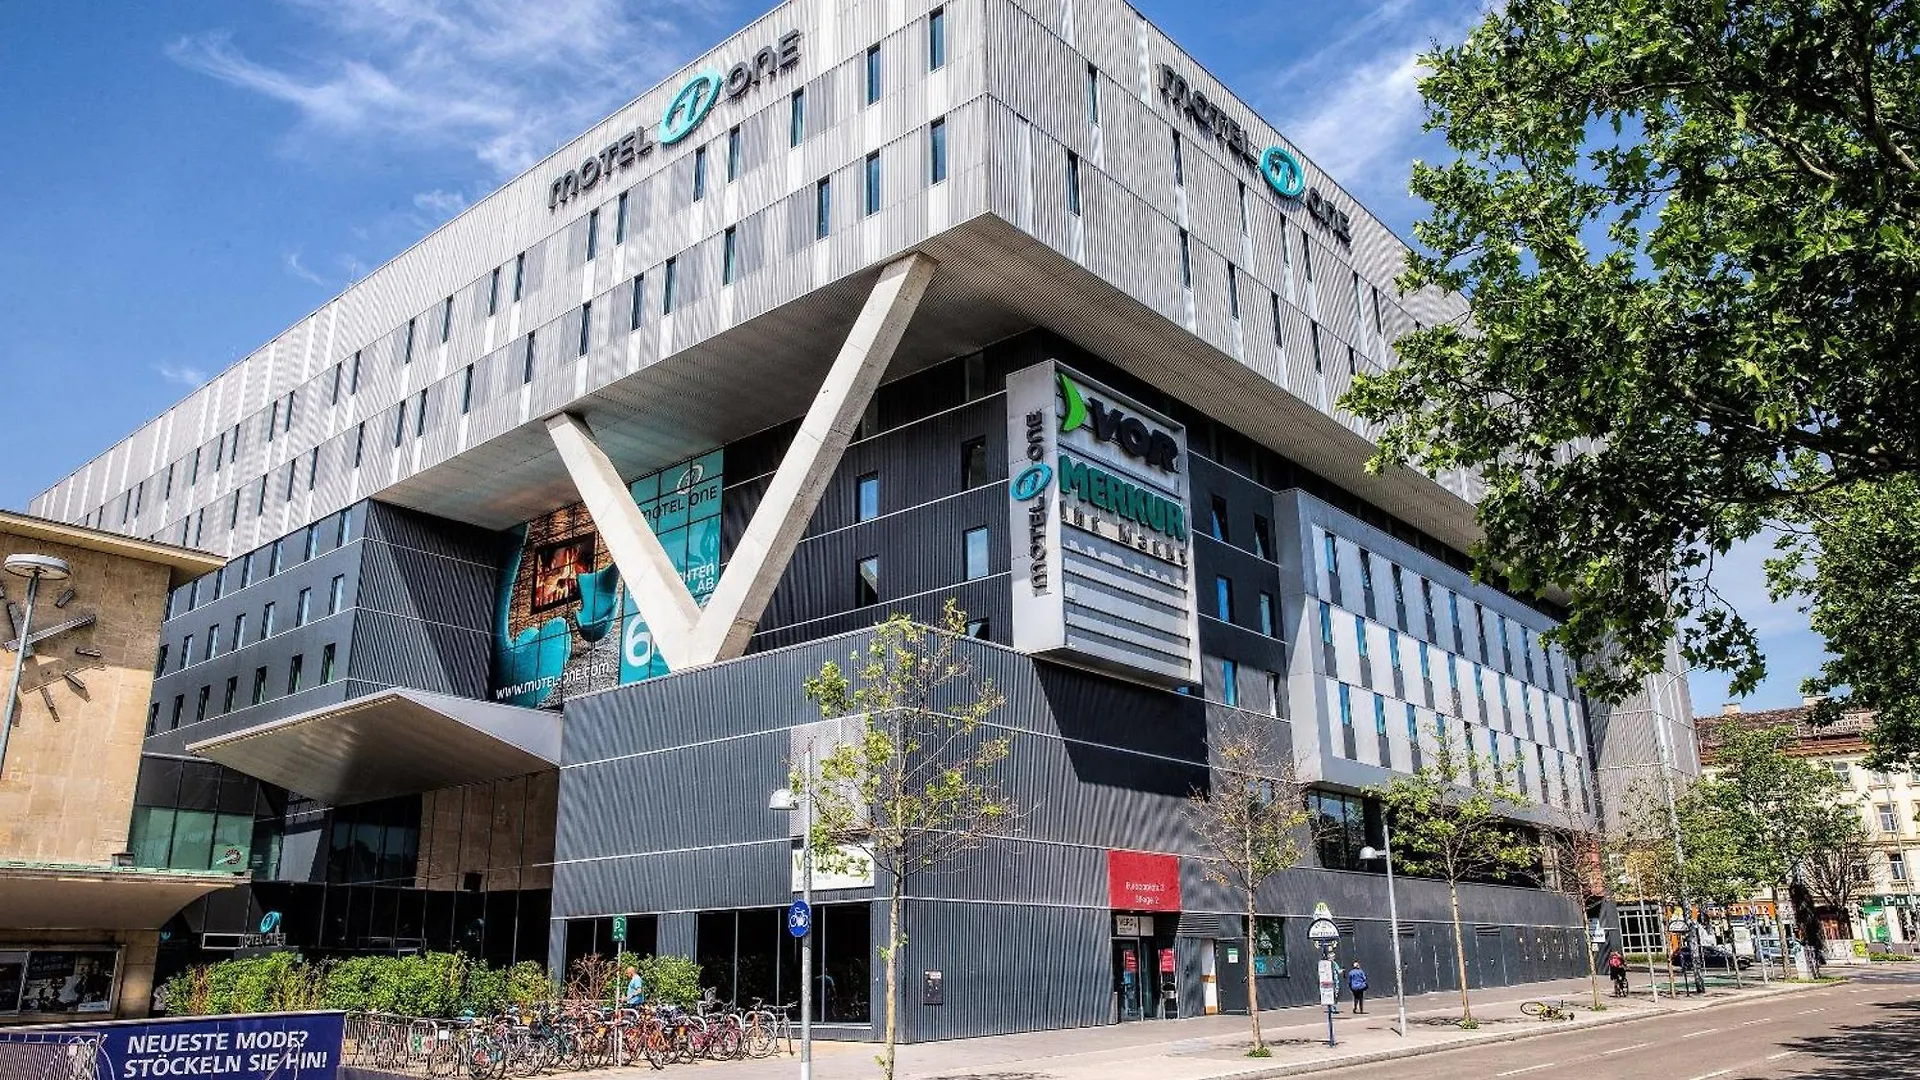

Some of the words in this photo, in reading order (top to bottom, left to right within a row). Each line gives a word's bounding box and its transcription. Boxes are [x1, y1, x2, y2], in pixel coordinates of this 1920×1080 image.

[1088, 397, 1178, 473] VOR
[1059, 455, 1185, 541] MERKUR
[123, 1055, 241, 1078] STÖCKELN
[248, 1053, 278, 1071] SIE
[286, 1051, 327, 1070] HIN!
[127, 1033, 230, 1053] NEUESTE
[236, 1031, 309, 1050] MODE?
